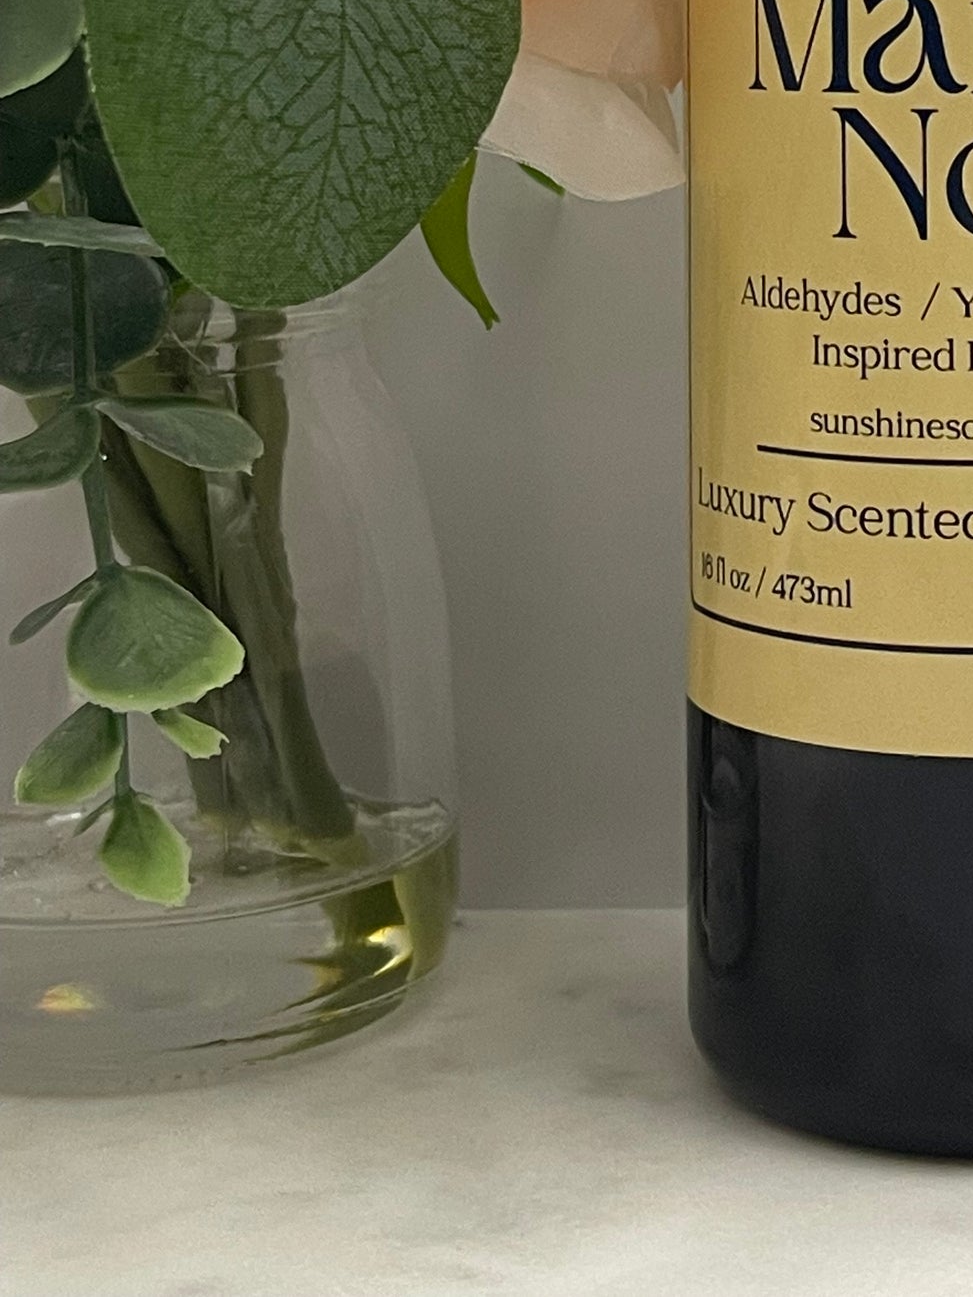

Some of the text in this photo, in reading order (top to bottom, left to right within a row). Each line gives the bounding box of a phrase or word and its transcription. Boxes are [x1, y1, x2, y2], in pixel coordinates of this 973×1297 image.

[741, 275, 901, 321] Aldehydes
[921, 282, 940, 321] /
[812, 334, 956, 380] Inspired
[699, 467, 796, 536] Luxury
[701, 551, 851, 608] 16 fl oz / 473ml
